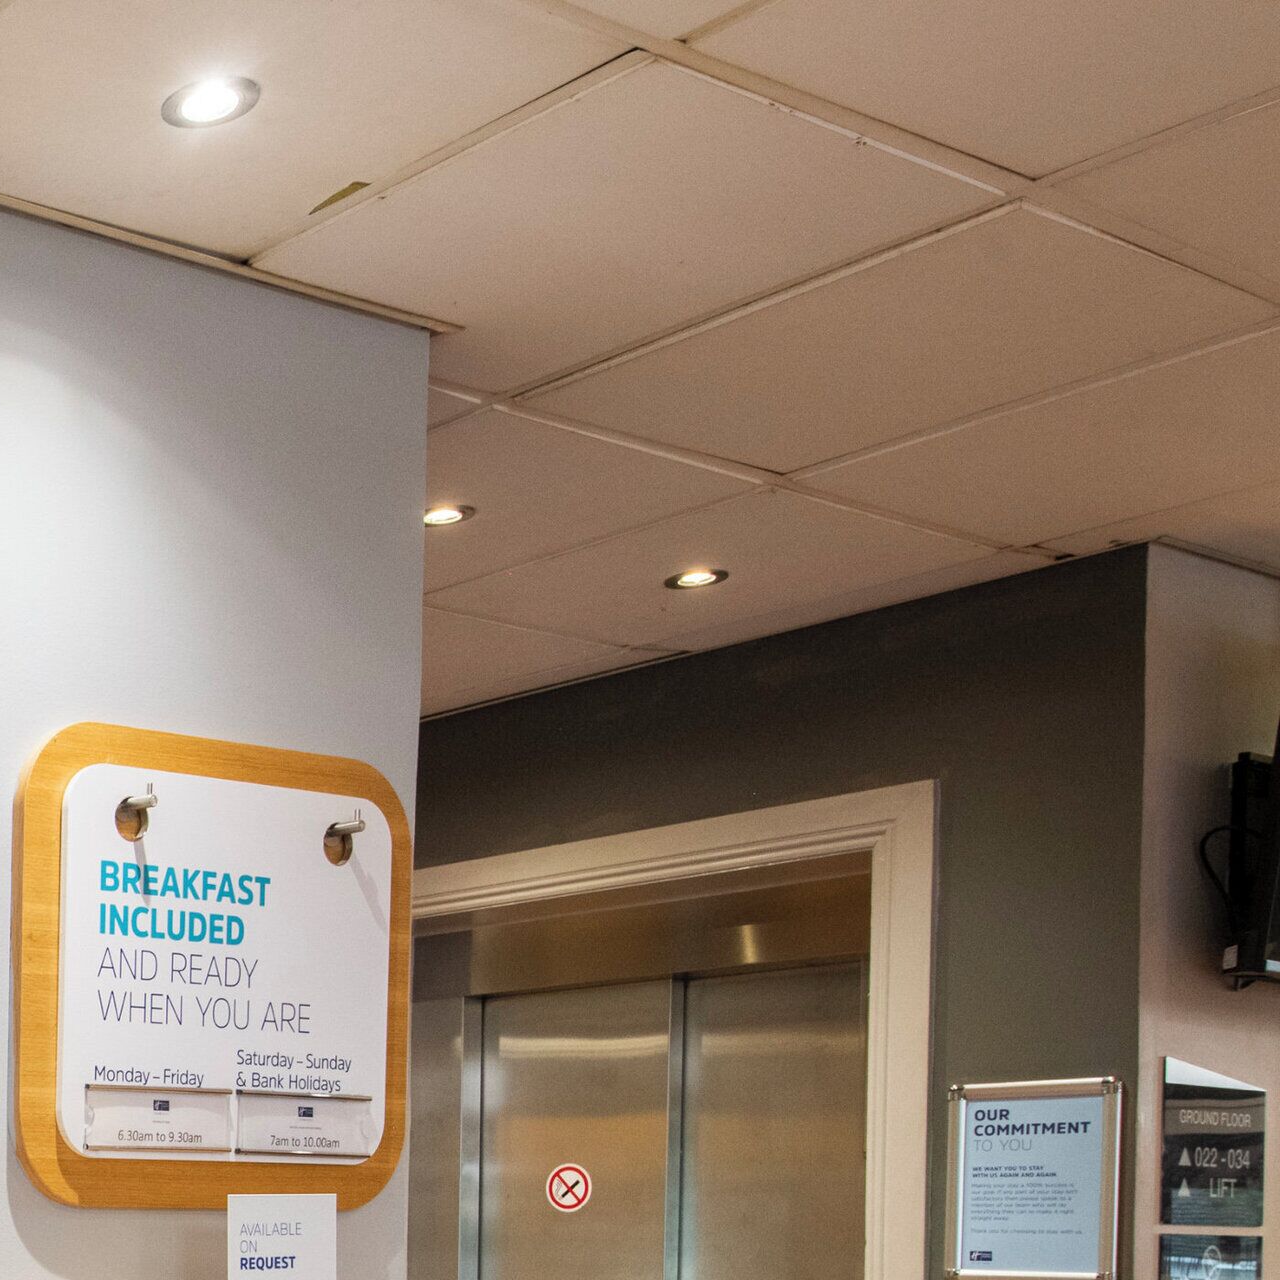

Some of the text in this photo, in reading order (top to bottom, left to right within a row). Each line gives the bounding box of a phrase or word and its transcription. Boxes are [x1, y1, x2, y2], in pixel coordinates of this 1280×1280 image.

[100, 860, 271, 907] BREAKFAST
[99, 905, 245, 946] INCLUDED
[97, 947, 258, 989] AND READY
[97, 990, 311, 1034] WHEN YOU ARE
[236, 1049, 294, 1069] Saturday
[306, 1053, 352, 1073] Sunday
[94, 1065, 150, 1085] Monday
[163, 1069, 204, 1088] Friday
[236, 1071, 341, 1092] & Bank Holidays
[974, 1108, 1010, 1122] OUR
[1179, 1109, 1252, 1128] GROUND FLOOR
[118, 1130, 202, 1144] 6.30am to 9.30am
[974, 1121, 1091, 1137] COMMITMENT
[271, 1135, 340, 1149] 7am to 10.00am
[973, 1138, 1033, 1152] TO YOU
[1194, 1146, 1218, 1168] 022
[1209, 1178, 1237, 1198] LIFT
[240, 1222, 303, 1236] AVAILABLE
[240, 1240, 258, 1254] ON
[240, 1256, 296, 1272] REQUEST
